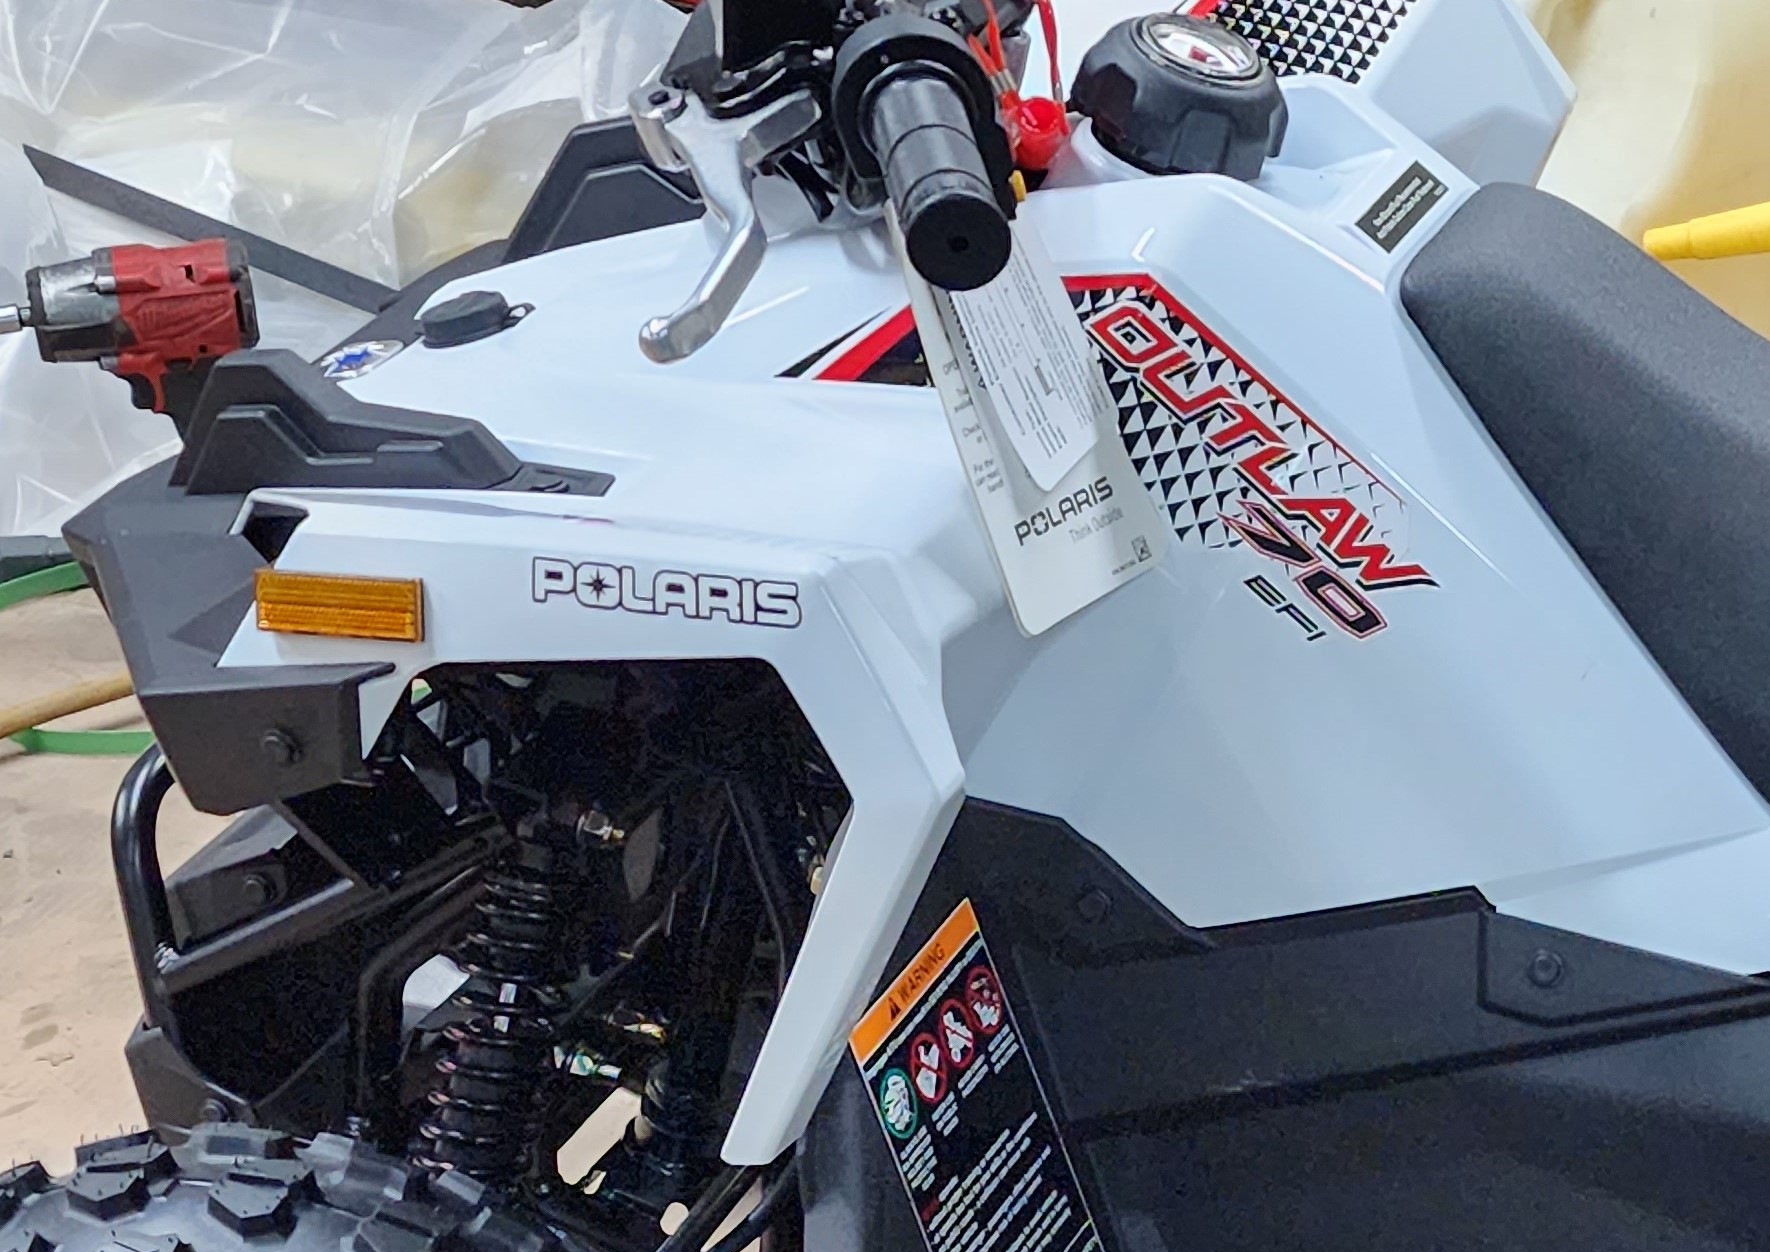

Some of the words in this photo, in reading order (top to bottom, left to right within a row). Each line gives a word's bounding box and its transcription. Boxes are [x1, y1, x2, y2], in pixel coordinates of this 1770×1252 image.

[1083, 300, 1441, 592] OUTLAW
[1014, 475, 1114, 547] POLARIS
[532, 556, 802, 629] POLARIS
[1216, 499, 1388, 640] 70
[1243, 574, 1327, 642] EFI
[897, 942, 945, 1002] WARNING
